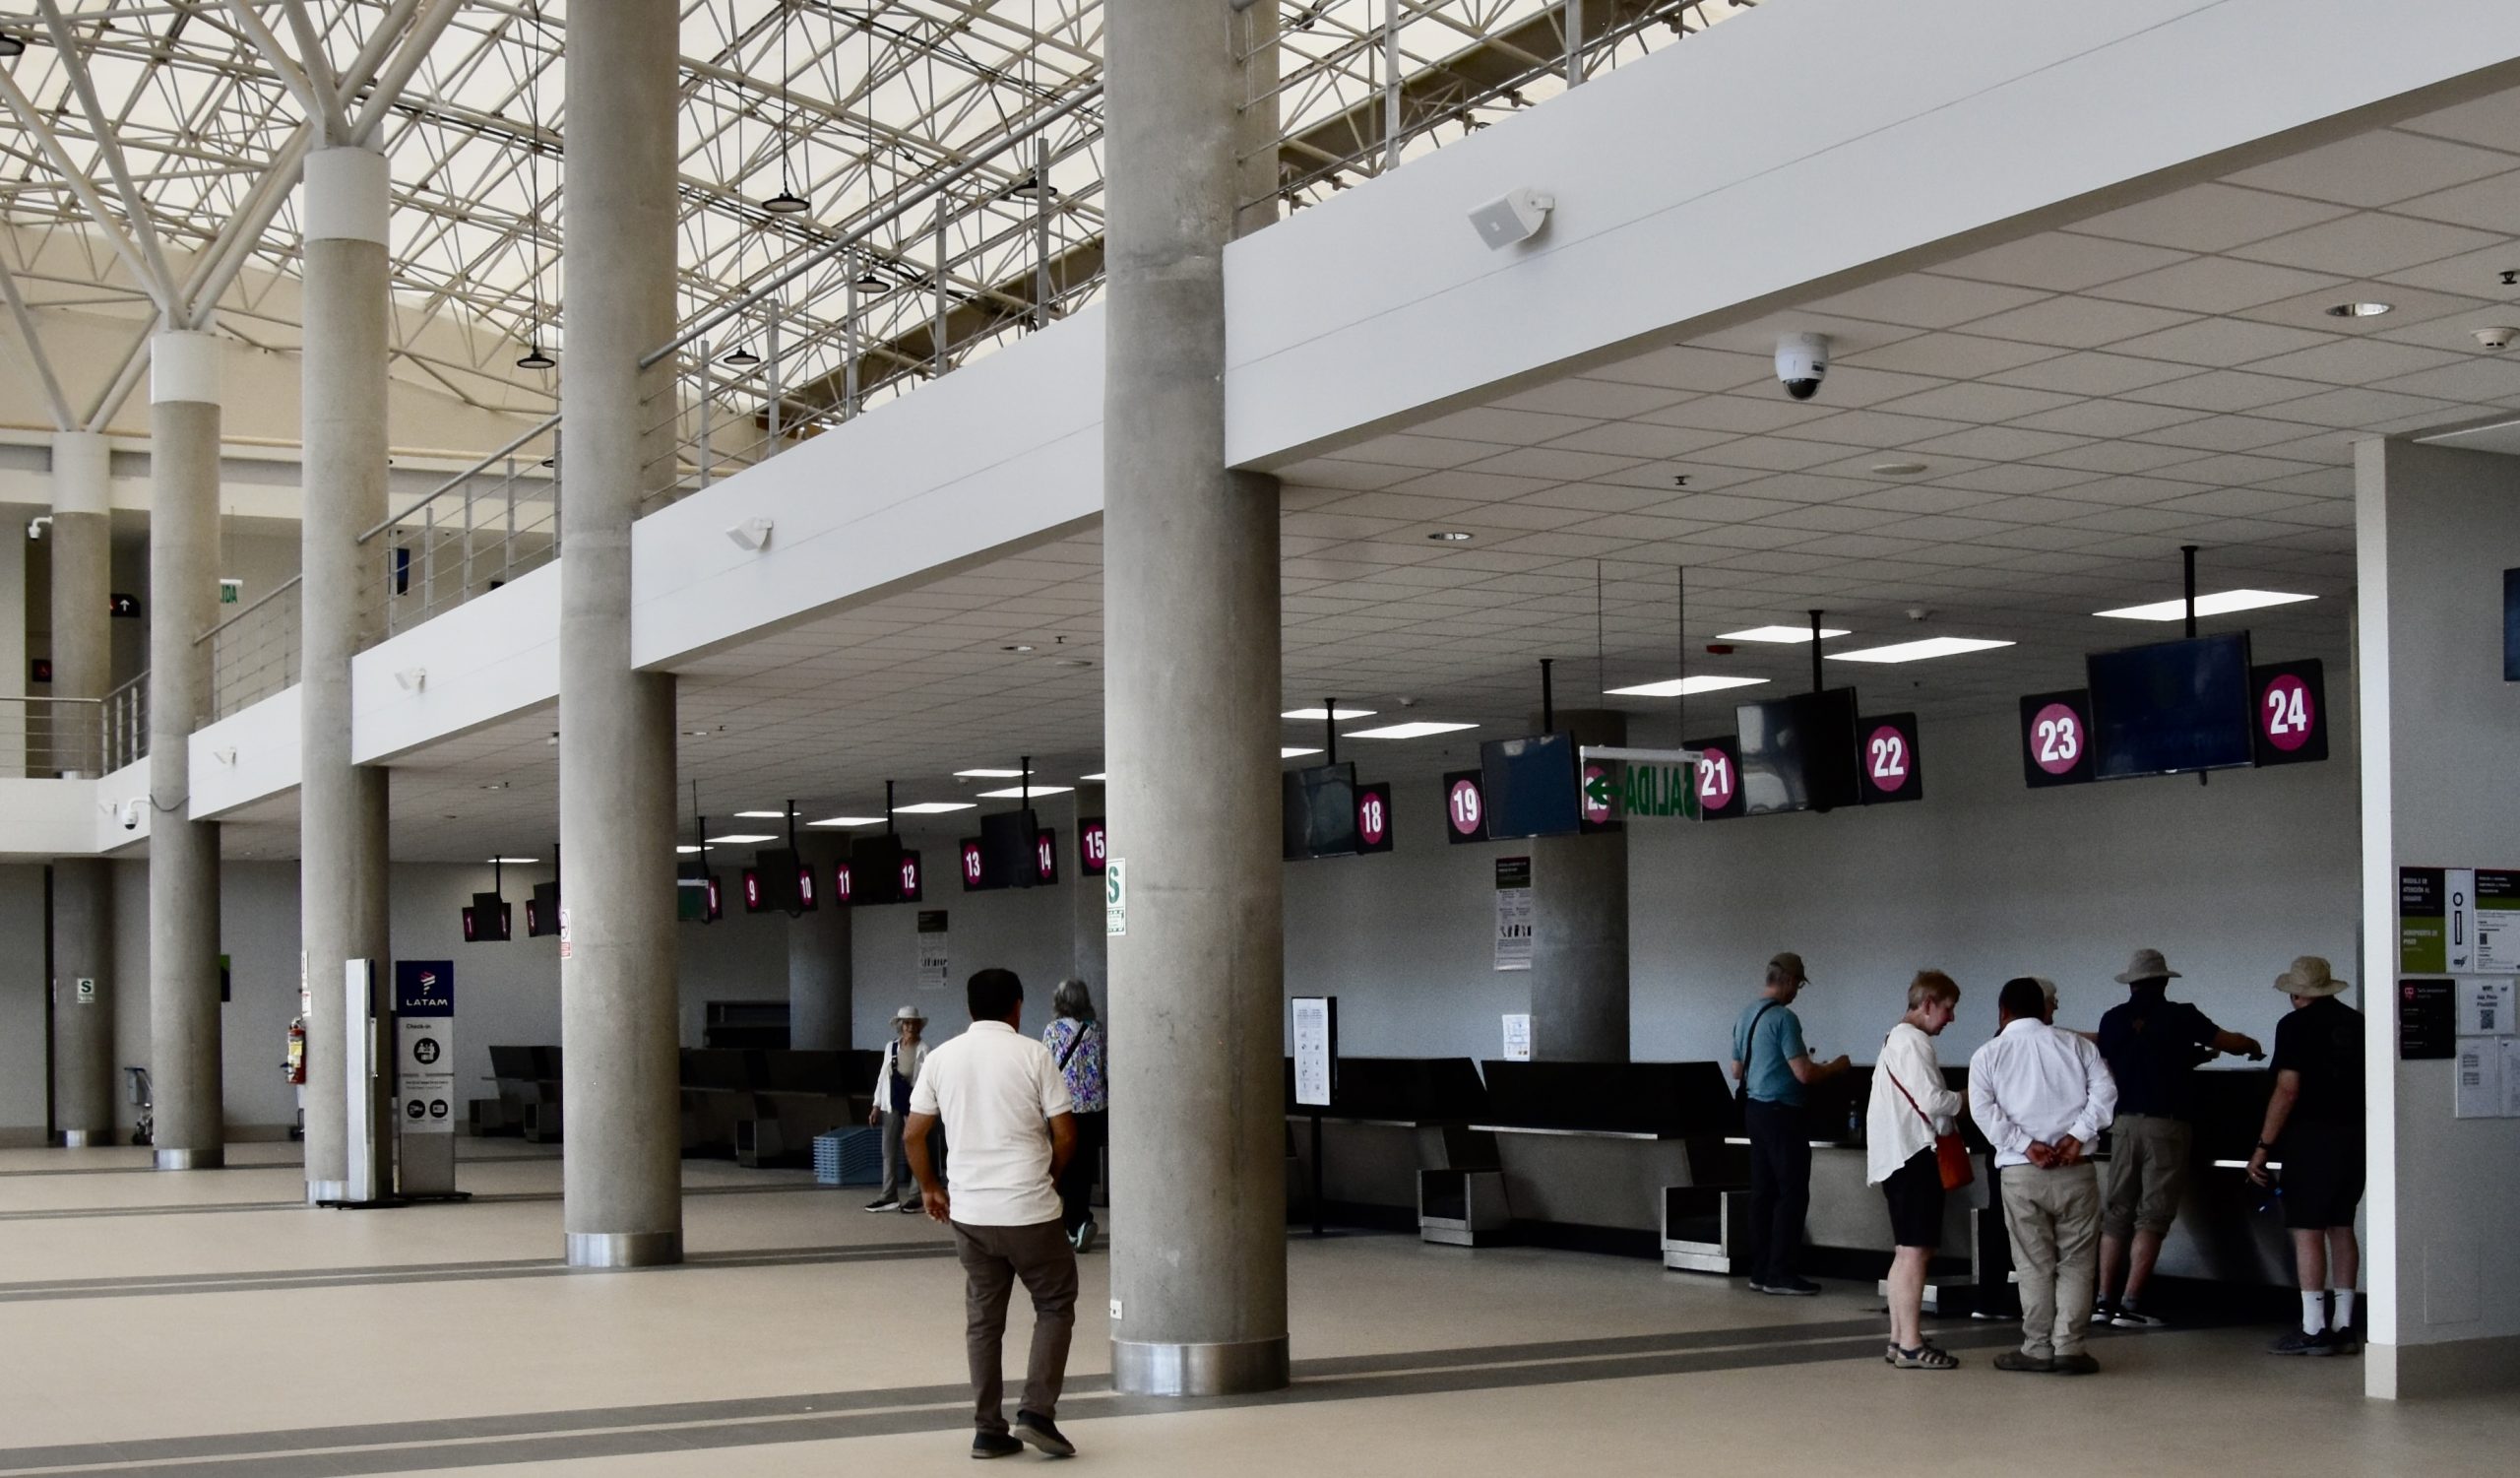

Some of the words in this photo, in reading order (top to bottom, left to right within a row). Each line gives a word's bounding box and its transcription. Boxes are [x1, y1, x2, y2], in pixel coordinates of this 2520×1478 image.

[2268, 687, 2306, 735] 24
[2038, 717, 2077, 762] 23
[1871, 737, 1905, 777] 22
[1700, 757, 1729, 797] 21
[1362, 800, 1382, 833] 18
[1453, 788, 1478, 822] 19
[1039, 843, 1051, 870] 14
[1086, 830, 1105, 859] 15
[902, 865, 915, 889] 12
[966, 851, 980, 877] 13
[749, 879, 756, 901] 9
[800, 876, 811, 898] 10
[839, 870, 850, 894] 11
[1107, 866, 1120, 904] S
[710, 886, 716, 908] 8
[81, 981, 92, 993] S
